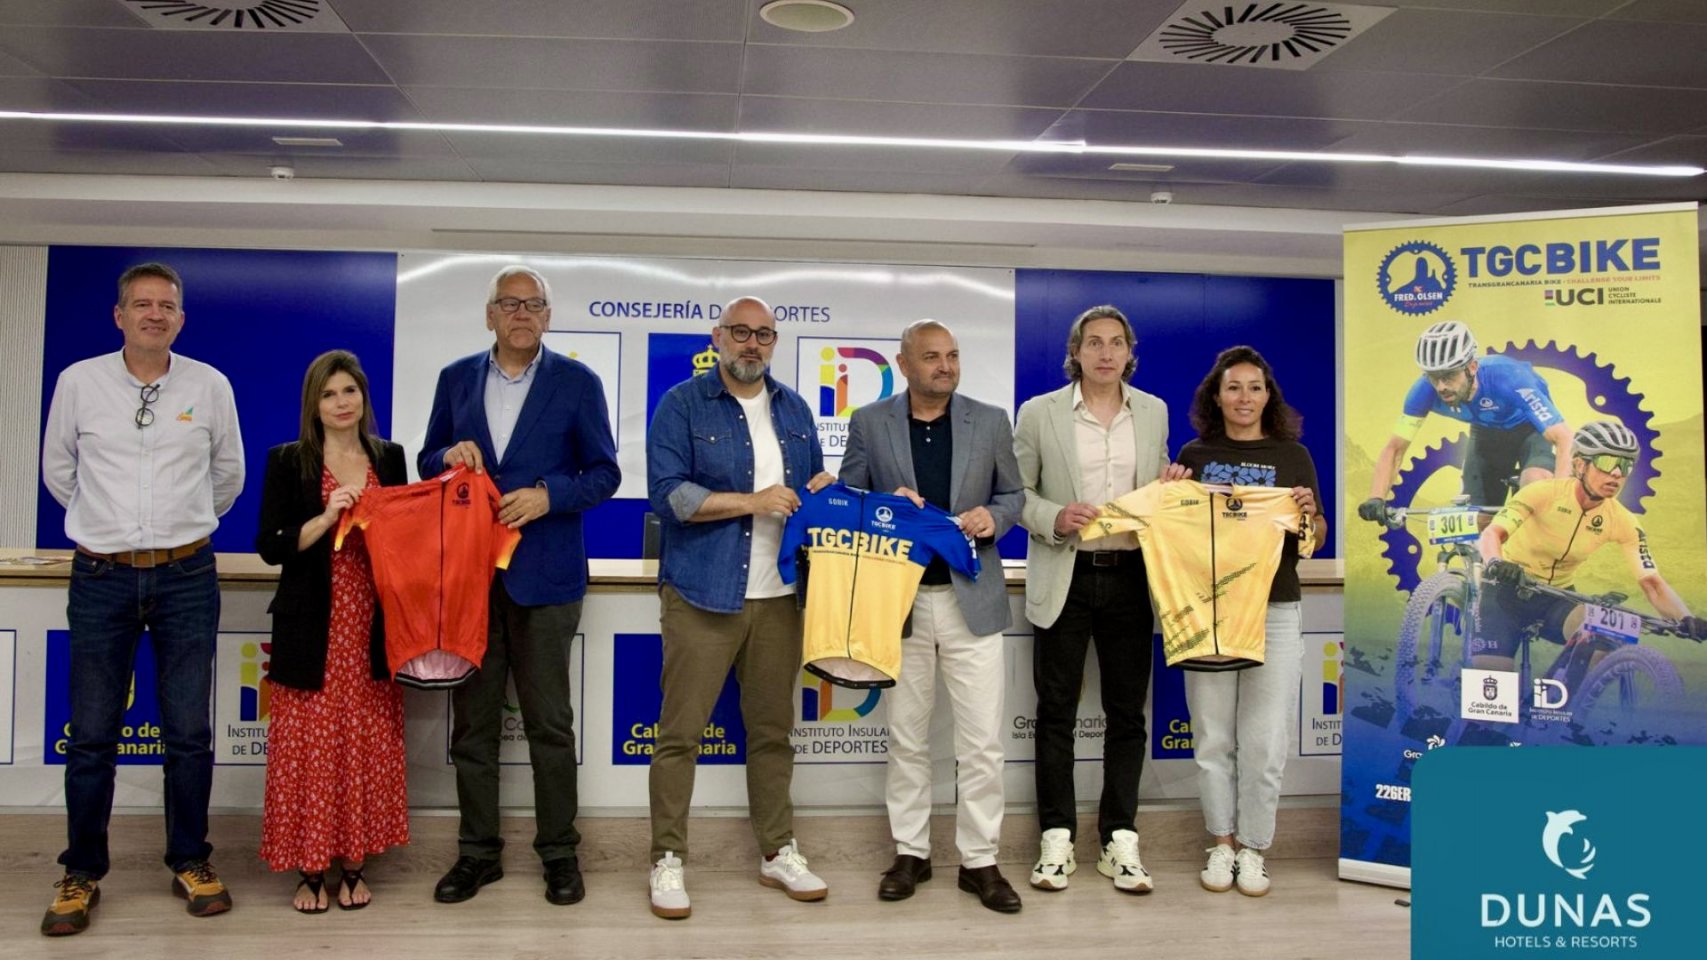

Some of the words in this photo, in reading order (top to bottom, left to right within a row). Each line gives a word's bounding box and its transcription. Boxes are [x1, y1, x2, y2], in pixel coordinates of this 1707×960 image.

[1460, 237, 1661, 278] TGCBIKE
[1417, 292, 1443, 300] OLSEN
[1556, 287, 1603, 306] UCI
[589, 300, 704, 319] CONSEJERÍA
[773, 306, 830, 323] ORTES
[1441, 514, 1462, 534] 301
[807, 527, 913, 561] TGCBIKE
[1600, 607, 1624, 630] 201
[138, 722, 161, 738] de
[704, 722, 725, 738] de
[848, 724, 890, 737] INSULA
[1013, 716, 1037, 729] Gra
[1312, 718, 1342, 730] INSTIT
[623, 740, 654, 755] Gra
[812, 740, 889, 754] DEPORTES
[1375, 784, 1411, 802] 226ER
